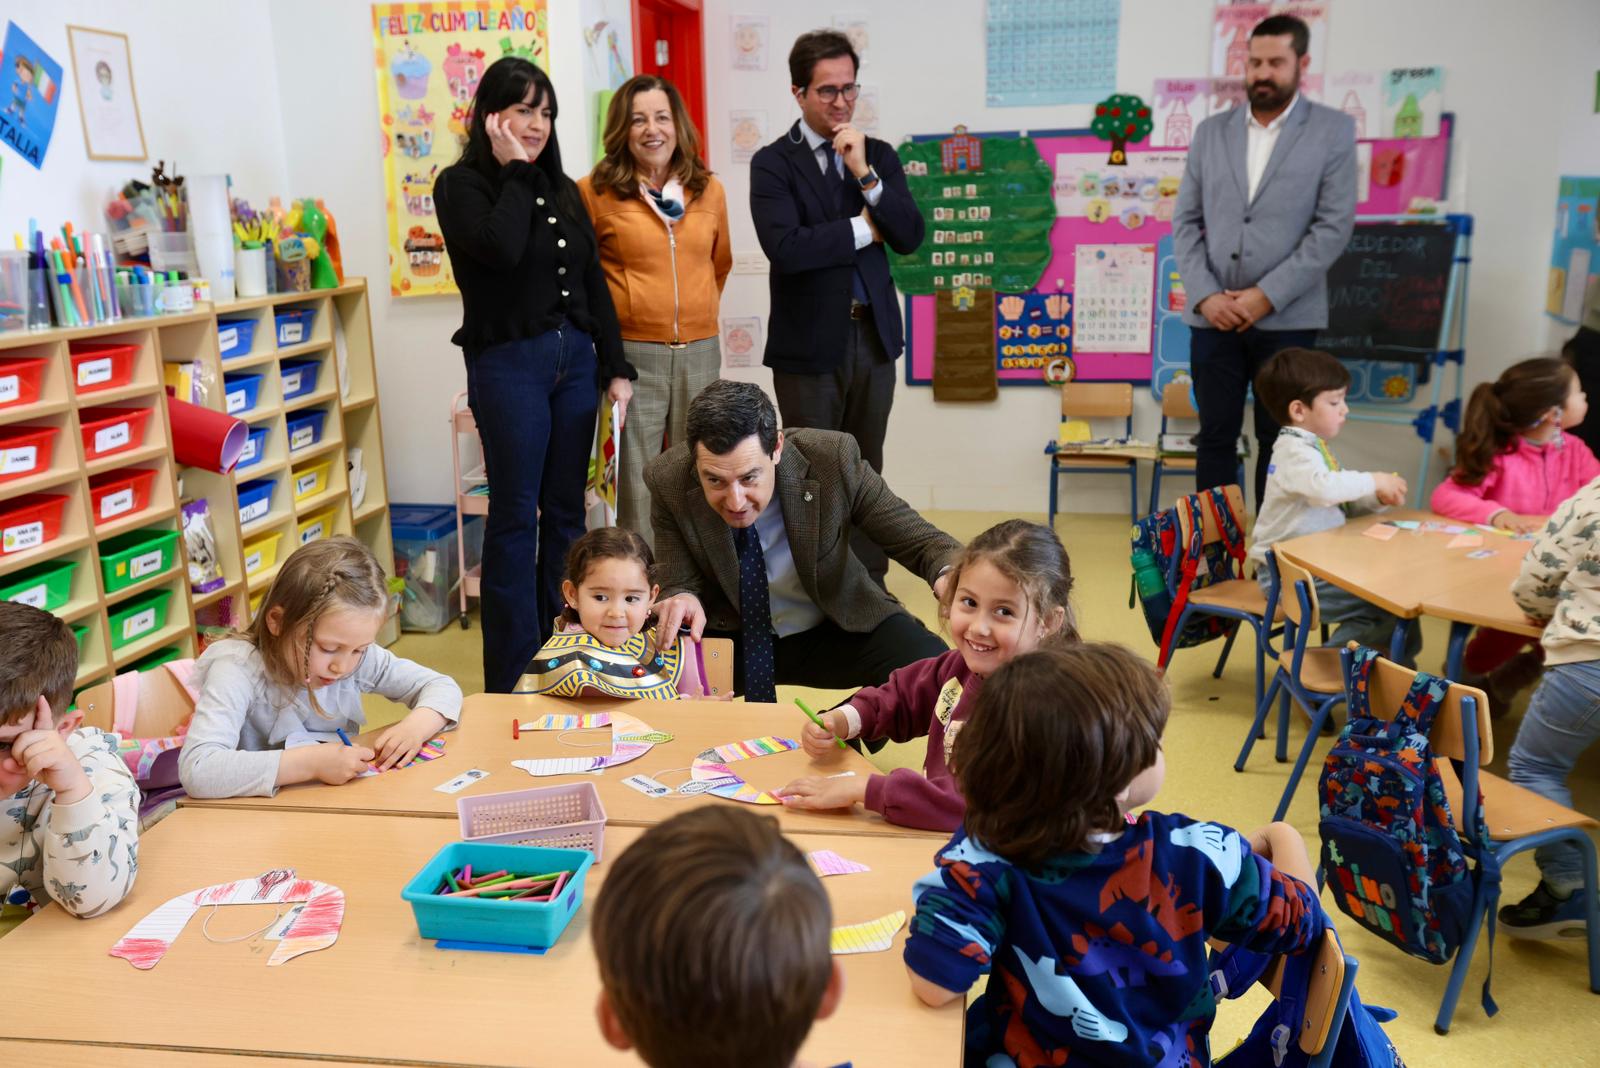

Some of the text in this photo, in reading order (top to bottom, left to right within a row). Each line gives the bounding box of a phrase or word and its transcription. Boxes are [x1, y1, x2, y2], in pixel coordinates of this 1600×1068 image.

[380, 5, 547, 37] FELIZ CUMPLEAÑOS
[1391, 67, 1435, 84] green
[1167, 81, 1195, 92] blue
[1348, 233, 1427, 257] EDEDOR
[1360, 258, 1398, 278] DEL
